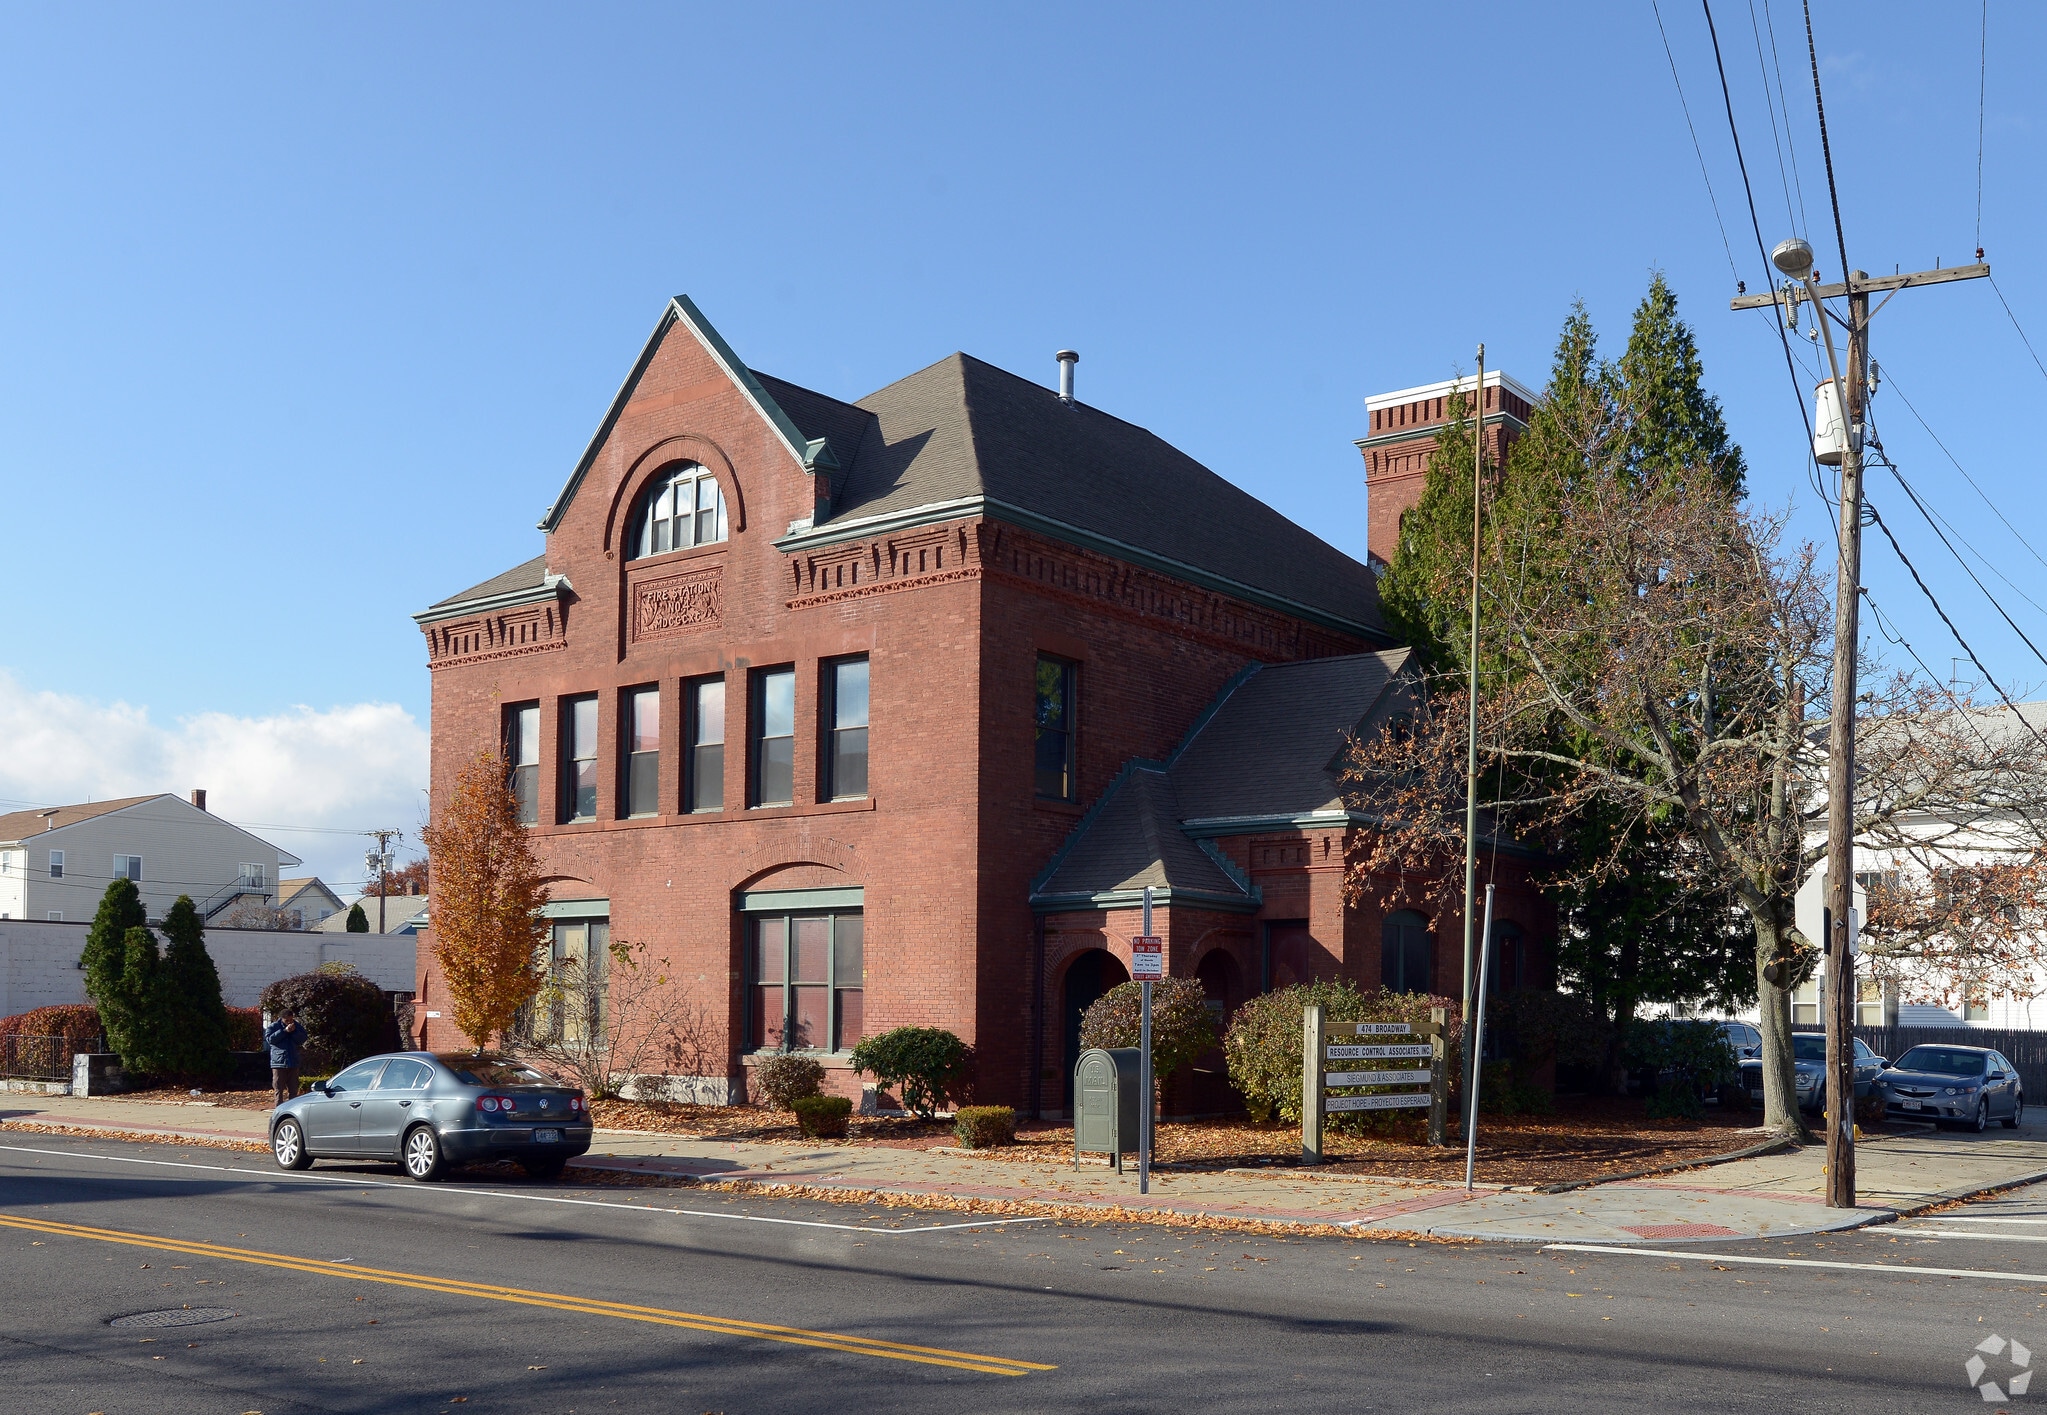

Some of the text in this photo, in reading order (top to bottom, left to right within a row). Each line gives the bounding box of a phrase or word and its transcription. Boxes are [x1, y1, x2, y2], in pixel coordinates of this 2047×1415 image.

[647, 582, 712, 603] FIRE STATION
[655, 612, 702, 629] MDCCCXC
[1361, 1024, 1407, 1033] 474 BROADWAY
[1330, 1046, 1359, 1056] RESOURCE
[1362, 1046, 1386, 1056] CONTROL
[1086, 1076, 1105, 1085] MAIL
[1346, 1074, 1376, 1083] SIEGMUND
[1382, 1072, 1414, 1082] ASSOCIATES
[1327, 1099, 1352, 1109] PROJECT
[1352, 1098, 1367, 1108] HOPE
[1371, 1097, 1399, 1107] PROYECTO
[1400, 1096, 1430, 1105] ESPERANZA
